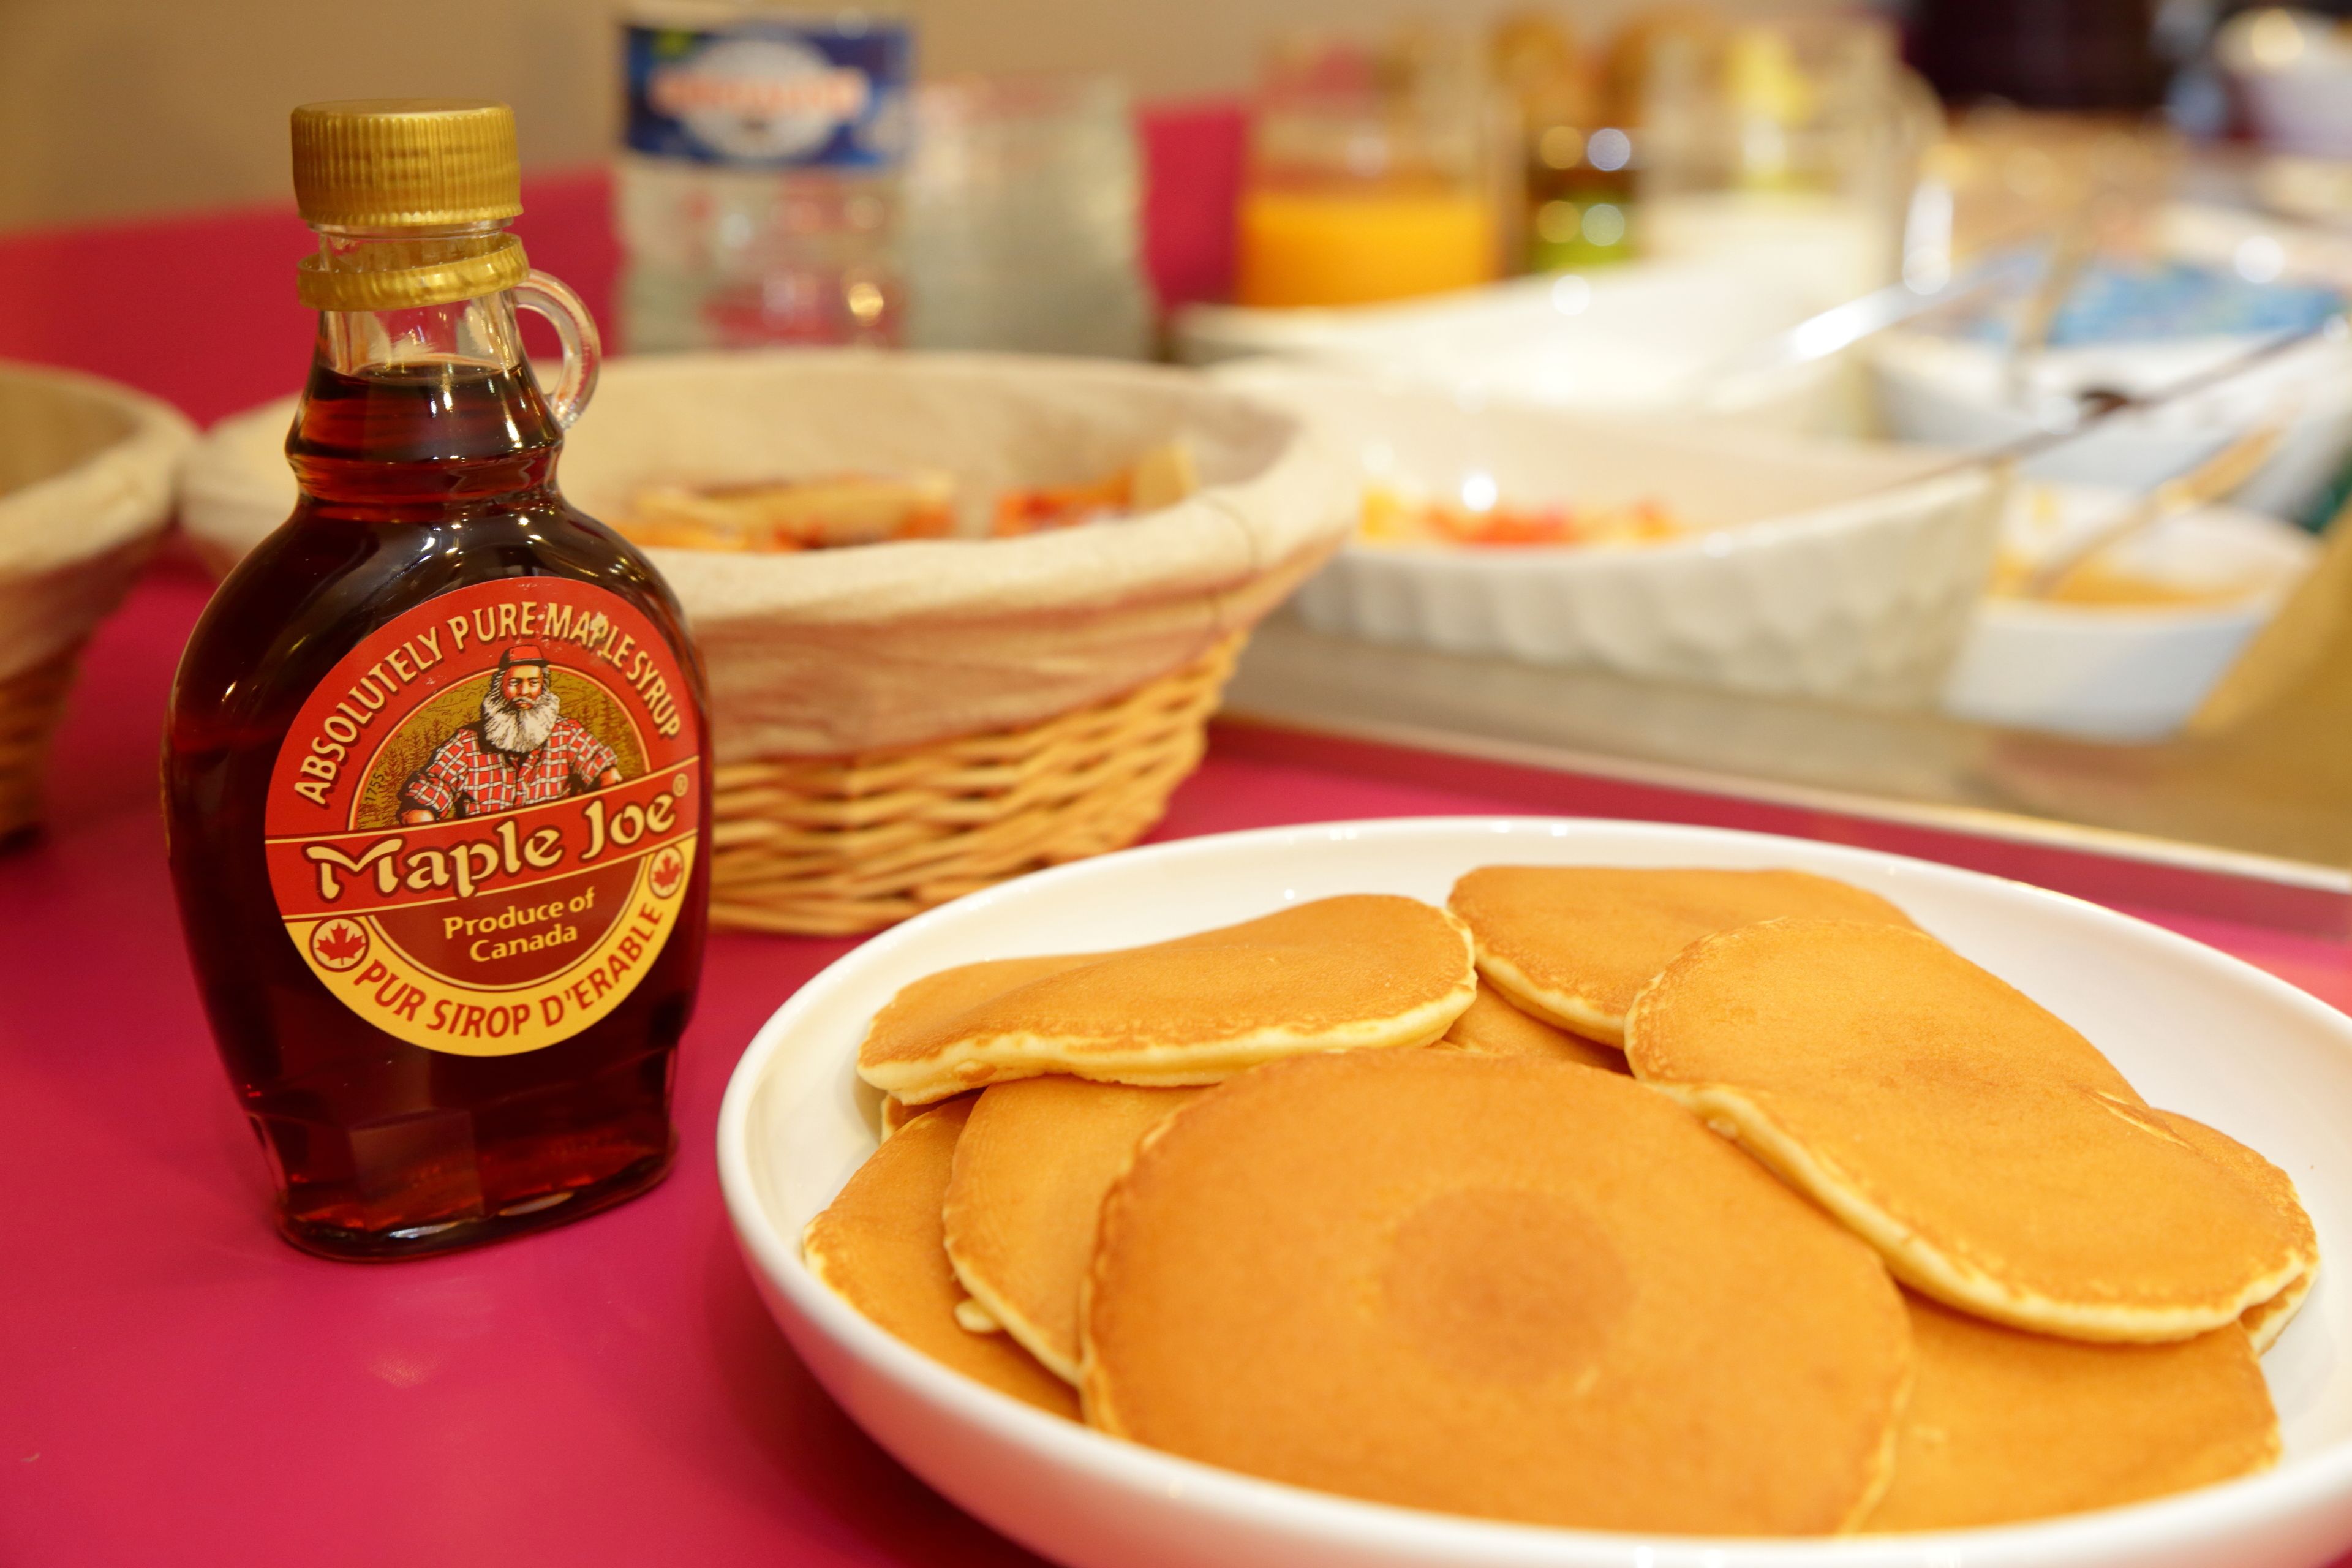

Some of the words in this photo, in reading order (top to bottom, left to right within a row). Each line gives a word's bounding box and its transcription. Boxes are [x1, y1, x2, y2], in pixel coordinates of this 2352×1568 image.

[294, 626, 443, 805] ABSOLUTELY
[447, 601, 537, 650] PURE
[542, 603, 635, 668] MAPLE
[626, 650, 682, 737] SYRUP
[306, 820, 563, 898] Maple
[443, 901, 564, 940] Produce
[568, 886, 596, 911] of
[469, 926, 578, 962] Canada
[353, 959, 427, 1022] PUR
[426, 998, 530, 1038] SIROP
[539, 902, 663, 1028] D'ERABLE
